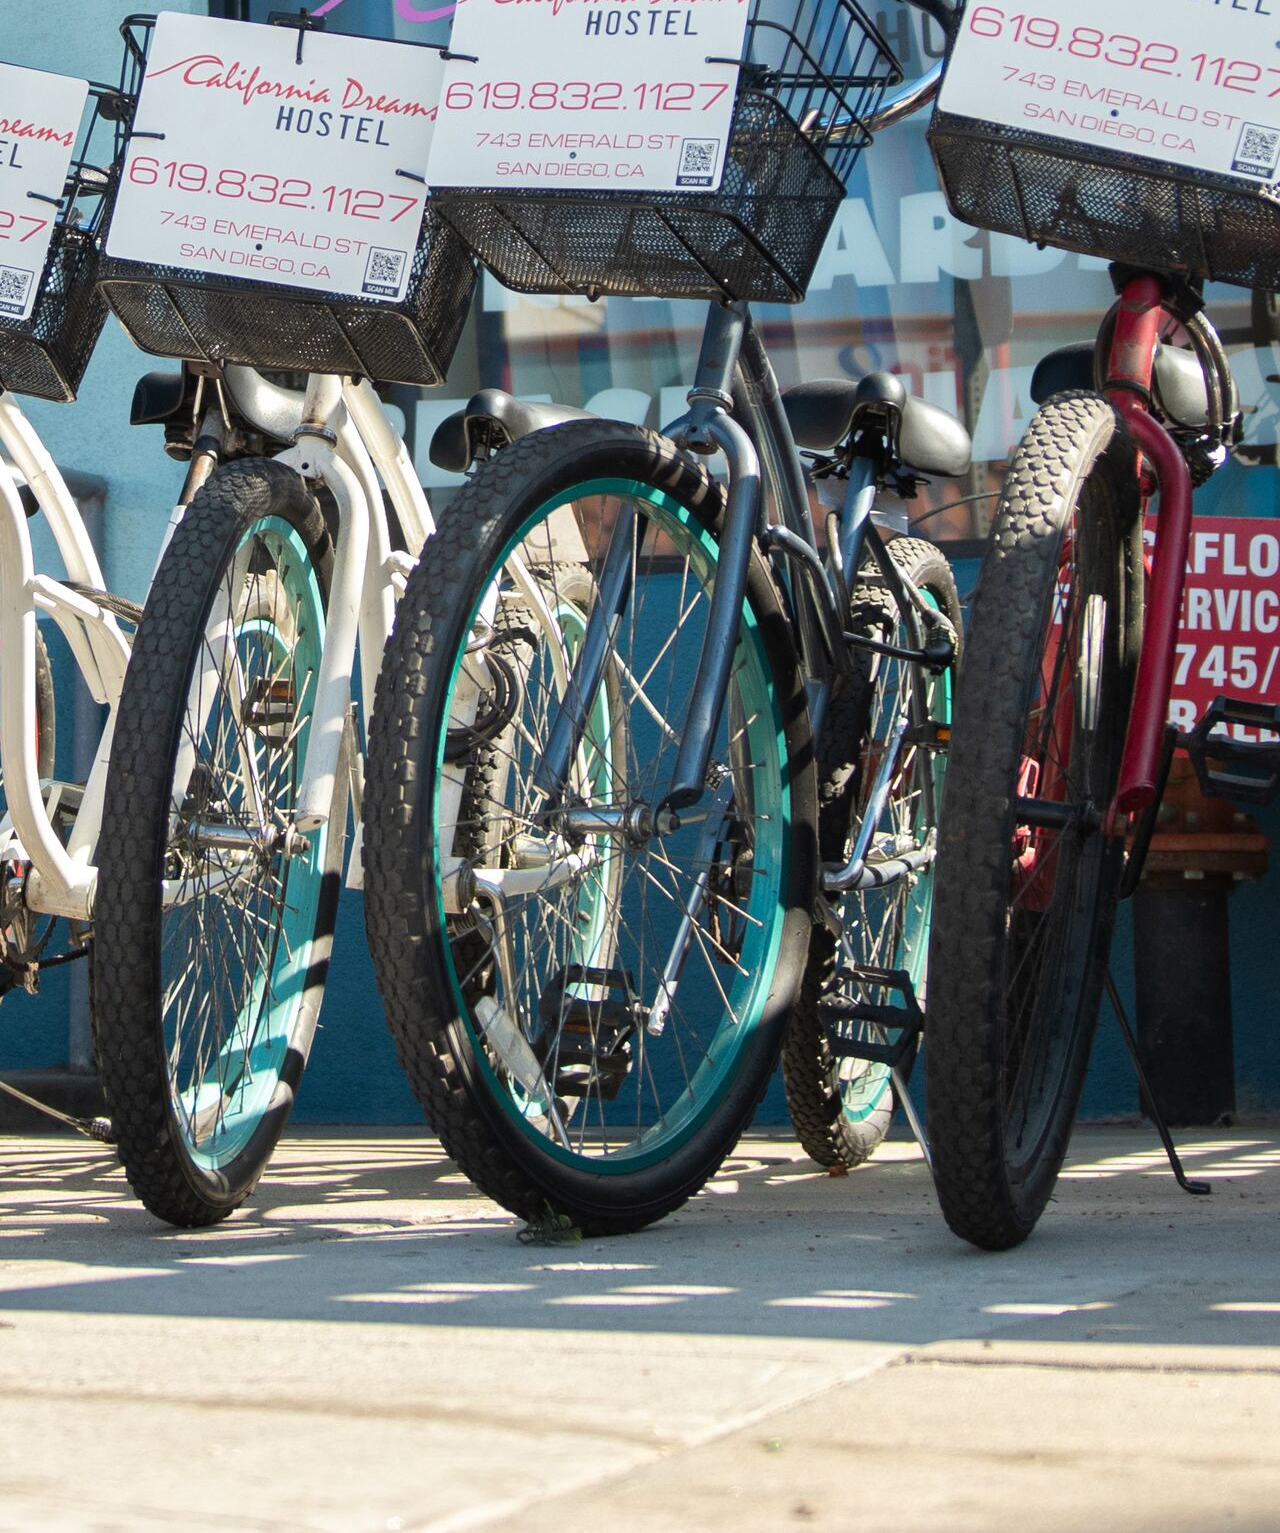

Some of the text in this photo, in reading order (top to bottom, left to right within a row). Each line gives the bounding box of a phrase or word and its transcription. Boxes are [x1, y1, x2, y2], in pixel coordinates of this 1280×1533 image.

[585, 10, 698, 36] HOSTEL
[145, 54, 438, 121] California Dreams
[445, 82, 729, 111] 619.832.1127
[1002, 65, 1240, 131] 743 EMERALD ST
[275, 105, 390, 147] HOSTEL
[475, 132, 680, 149] 743 EMERALD ST
[1023, 102, 1196, 153] SAN DIEGO, CA
[129, 156, 418, 223] 619.832.1127
[495, 162, 645, 179] SAN DIEGO, CA
[160, 211, 368, 256] 743 EMERALD ST
[179, 243, 331, 279] SAN DIEGO, CA
